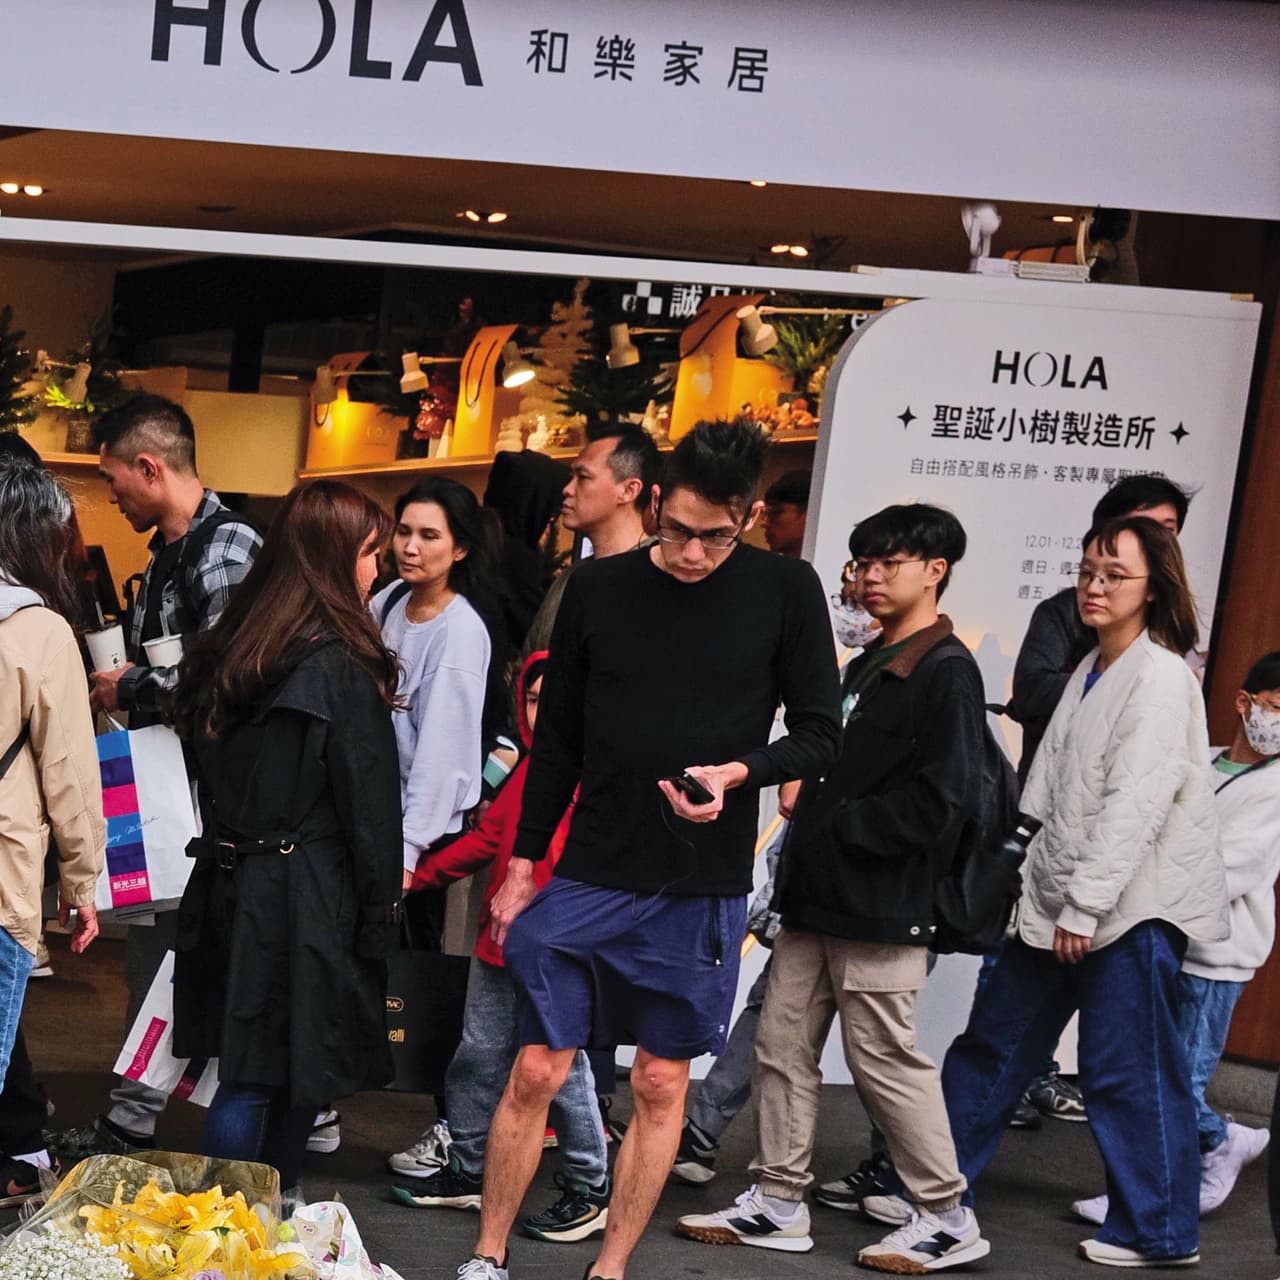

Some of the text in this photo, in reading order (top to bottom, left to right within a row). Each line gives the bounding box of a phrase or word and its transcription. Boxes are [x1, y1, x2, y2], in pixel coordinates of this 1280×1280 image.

[151, 0, 484, 87] HOLA
[526, 28, 769, 93] 和樂家居
[991, 350, 1109, 391] HOLA
[930, 404, 1157, 451] 聖誕小樹製造所
